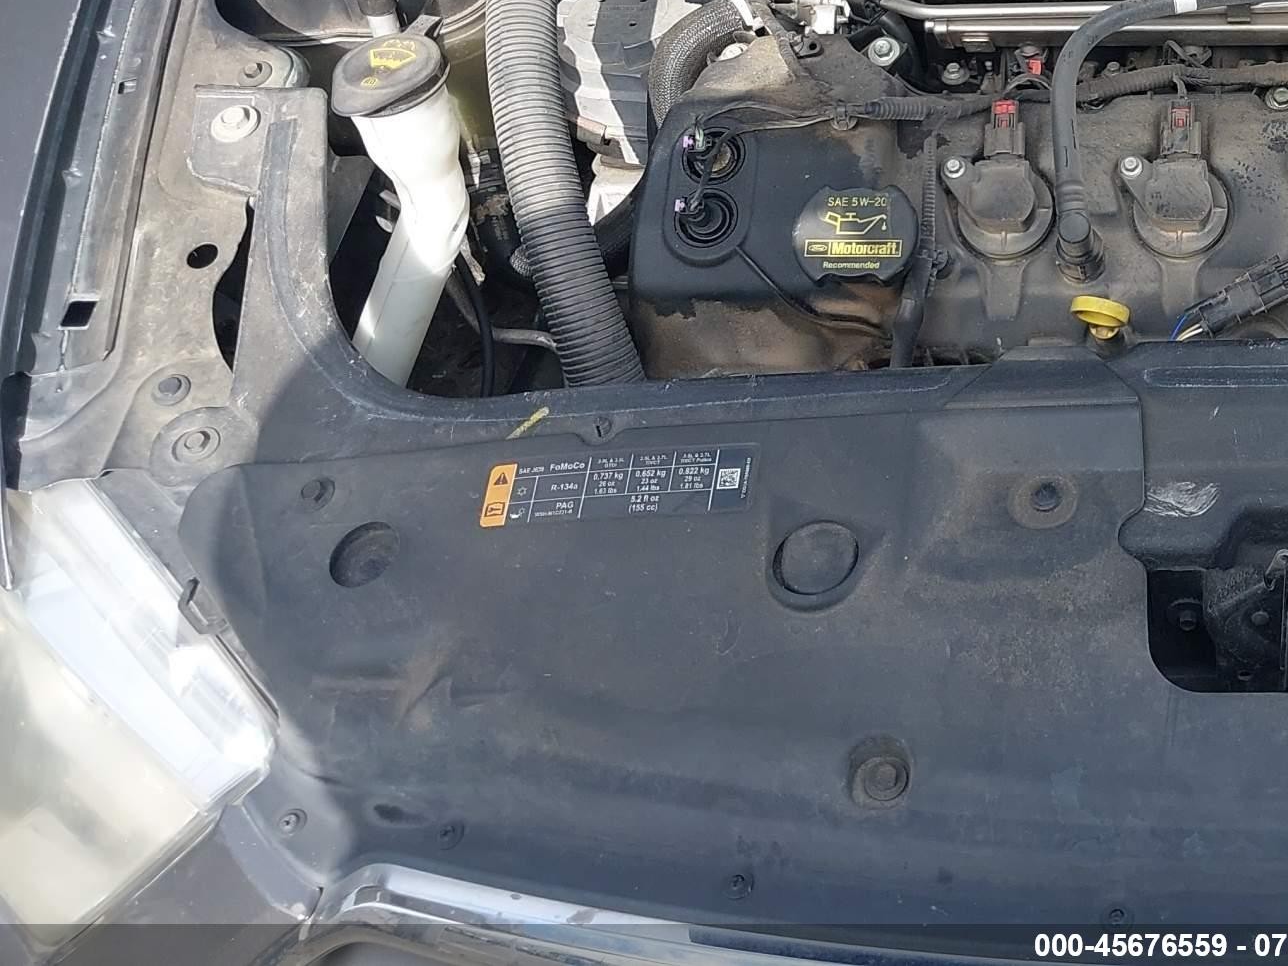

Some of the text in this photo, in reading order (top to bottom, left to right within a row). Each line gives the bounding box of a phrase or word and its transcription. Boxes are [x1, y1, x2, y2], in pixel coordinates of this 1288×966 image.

[827, 196, 887, 207] SAE 5W-20
[831, 242, 897, 255] Motorcraft
[822, 261, 880, 269] Recommended
[550, 461, 585, 472] FoMoCo
[678, 466, 710, 476] 0.822 kg
[593, 471, 624, 481] 0.737 kg
[656, 469, 667, 479] kg
[551, 483, 579, 491] R-134a
[630, 495, 643, 503] 5.2
[556, 501, 574, 510] PAG
[628, 503, 658, 515] (155 cc)
